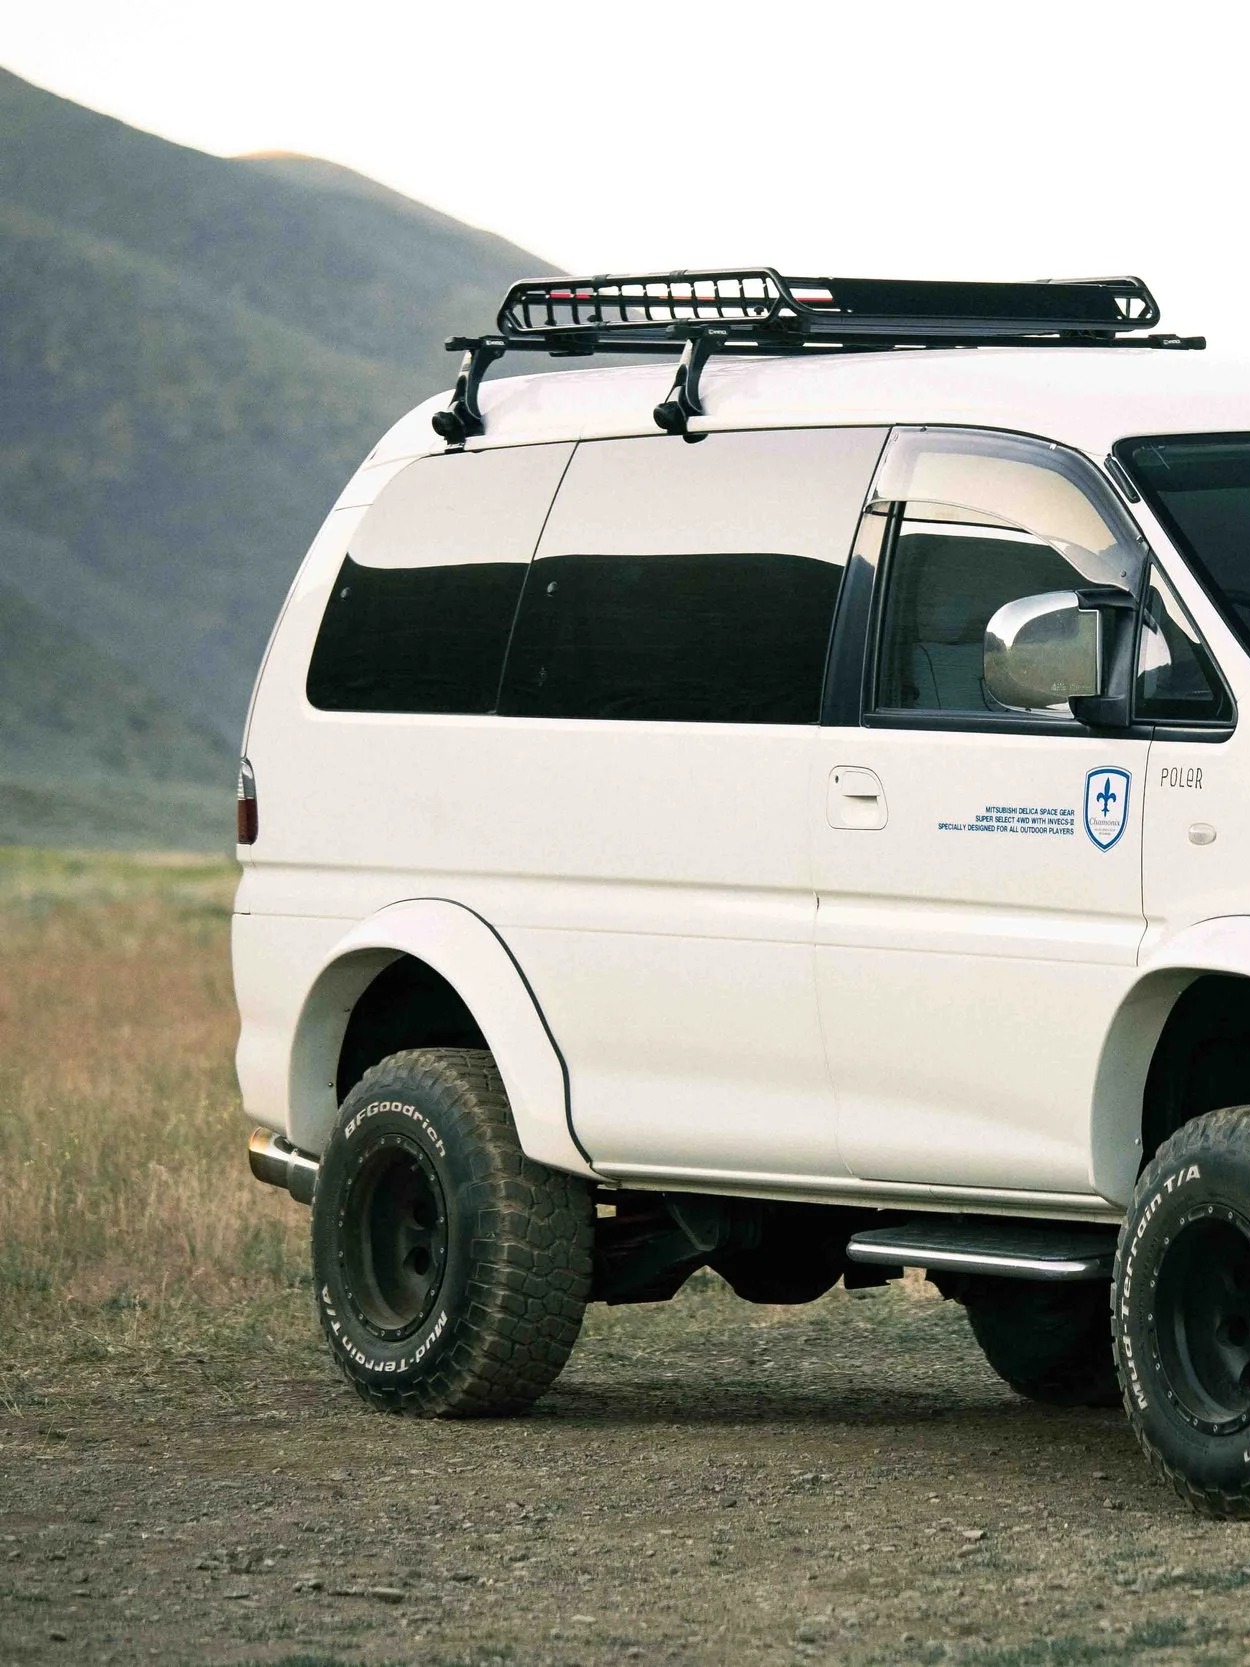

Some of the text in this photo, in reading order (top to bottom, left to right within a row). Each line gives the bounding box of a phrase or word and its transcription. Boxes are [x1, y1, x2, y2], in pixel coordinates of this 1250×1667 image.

[975, 815, 994, 823] SUPER
[994, 816, 1016, 824] SELECT
[1031, 817, 1047, 825] WITH
[985, 806, 1075, 817] MITSUBISHI DELICA SPACE GEAR
[938, 823, 967, 831] SPECIALLY
[967, 824, 996, 832] DESIGNED
[996, 825, 1008, 833] FOR
[1020, 826, 1048, 834] OUTDOOR
[1048, 827, 1075, 835] PLAYERS
[344, 1101, 448, 1158] BFGoodrich
[1121, 1193, 1162, 1411] Mud-Terrain
[1163, 1163, 1201, 1195] T/A
[343, 1310, 448, 1374] Mud-Terrain
